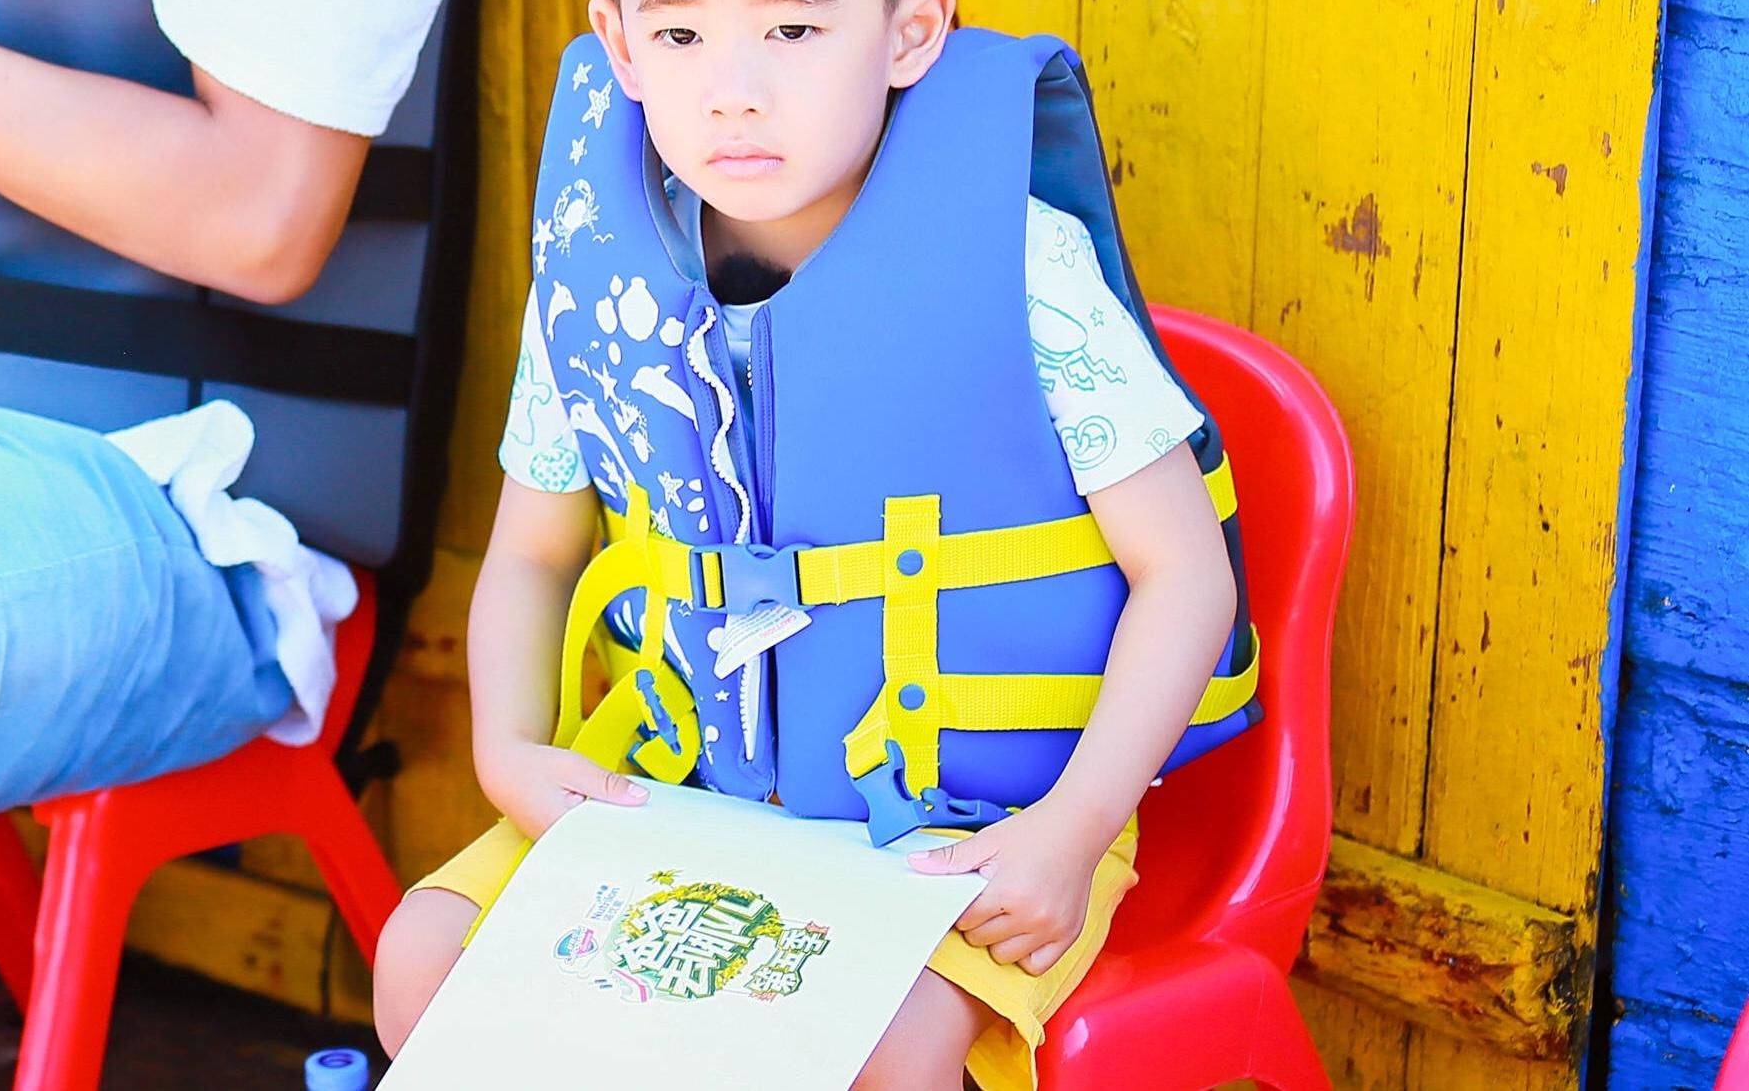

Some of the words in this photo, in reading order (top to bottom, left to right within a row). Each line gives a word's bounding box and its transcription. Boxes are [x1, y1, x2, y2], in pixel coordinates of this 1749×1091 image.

[607, 899, 705, 973] 爸爸
[656, 897, 773, 998] 去哪儿
[745, 929, 829, 995] 第五季
